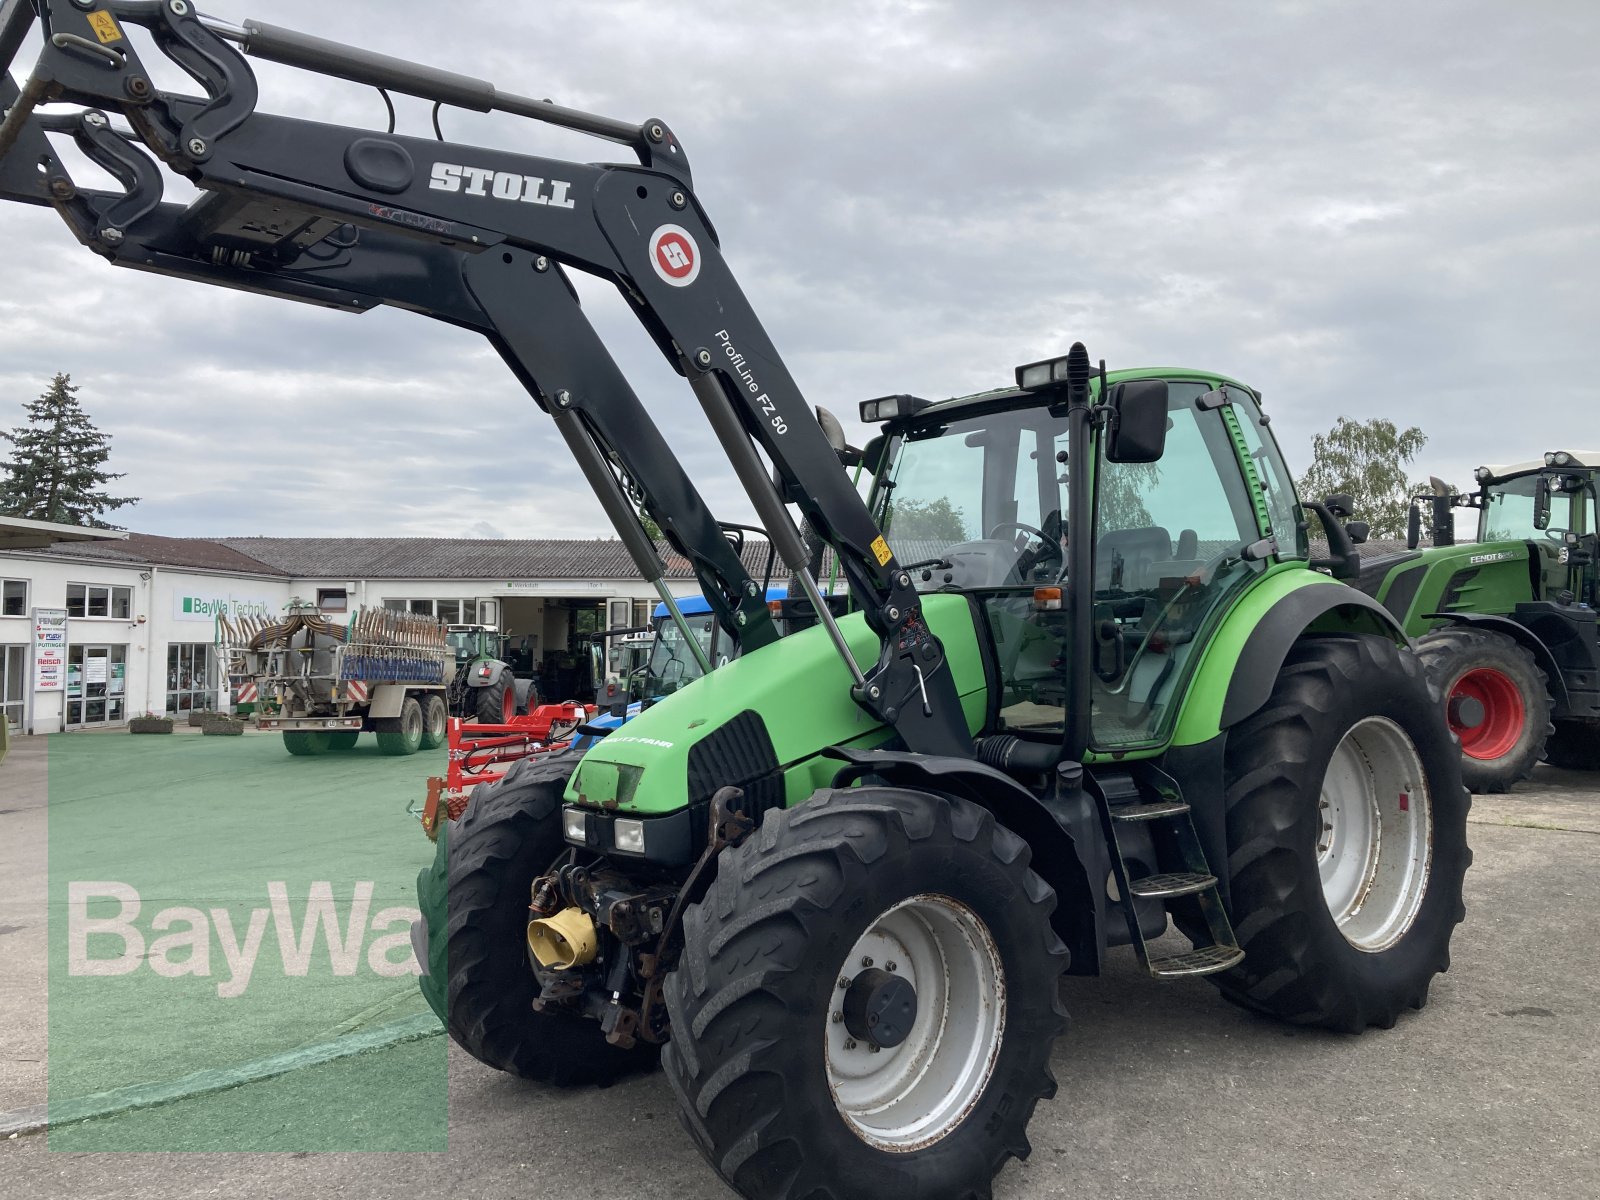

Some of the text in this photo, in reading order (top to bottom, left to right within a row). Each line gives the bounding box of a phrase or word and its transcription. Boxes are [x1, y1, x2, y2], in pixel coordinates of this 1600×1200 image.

[429, 161, 575, 209] STOLL
[714, 329, 788, 435] ProfiLine FZ 50
[1470, 553, 1497, 564] FENDT
[194, 598, 268, 618] BayWa Technik
